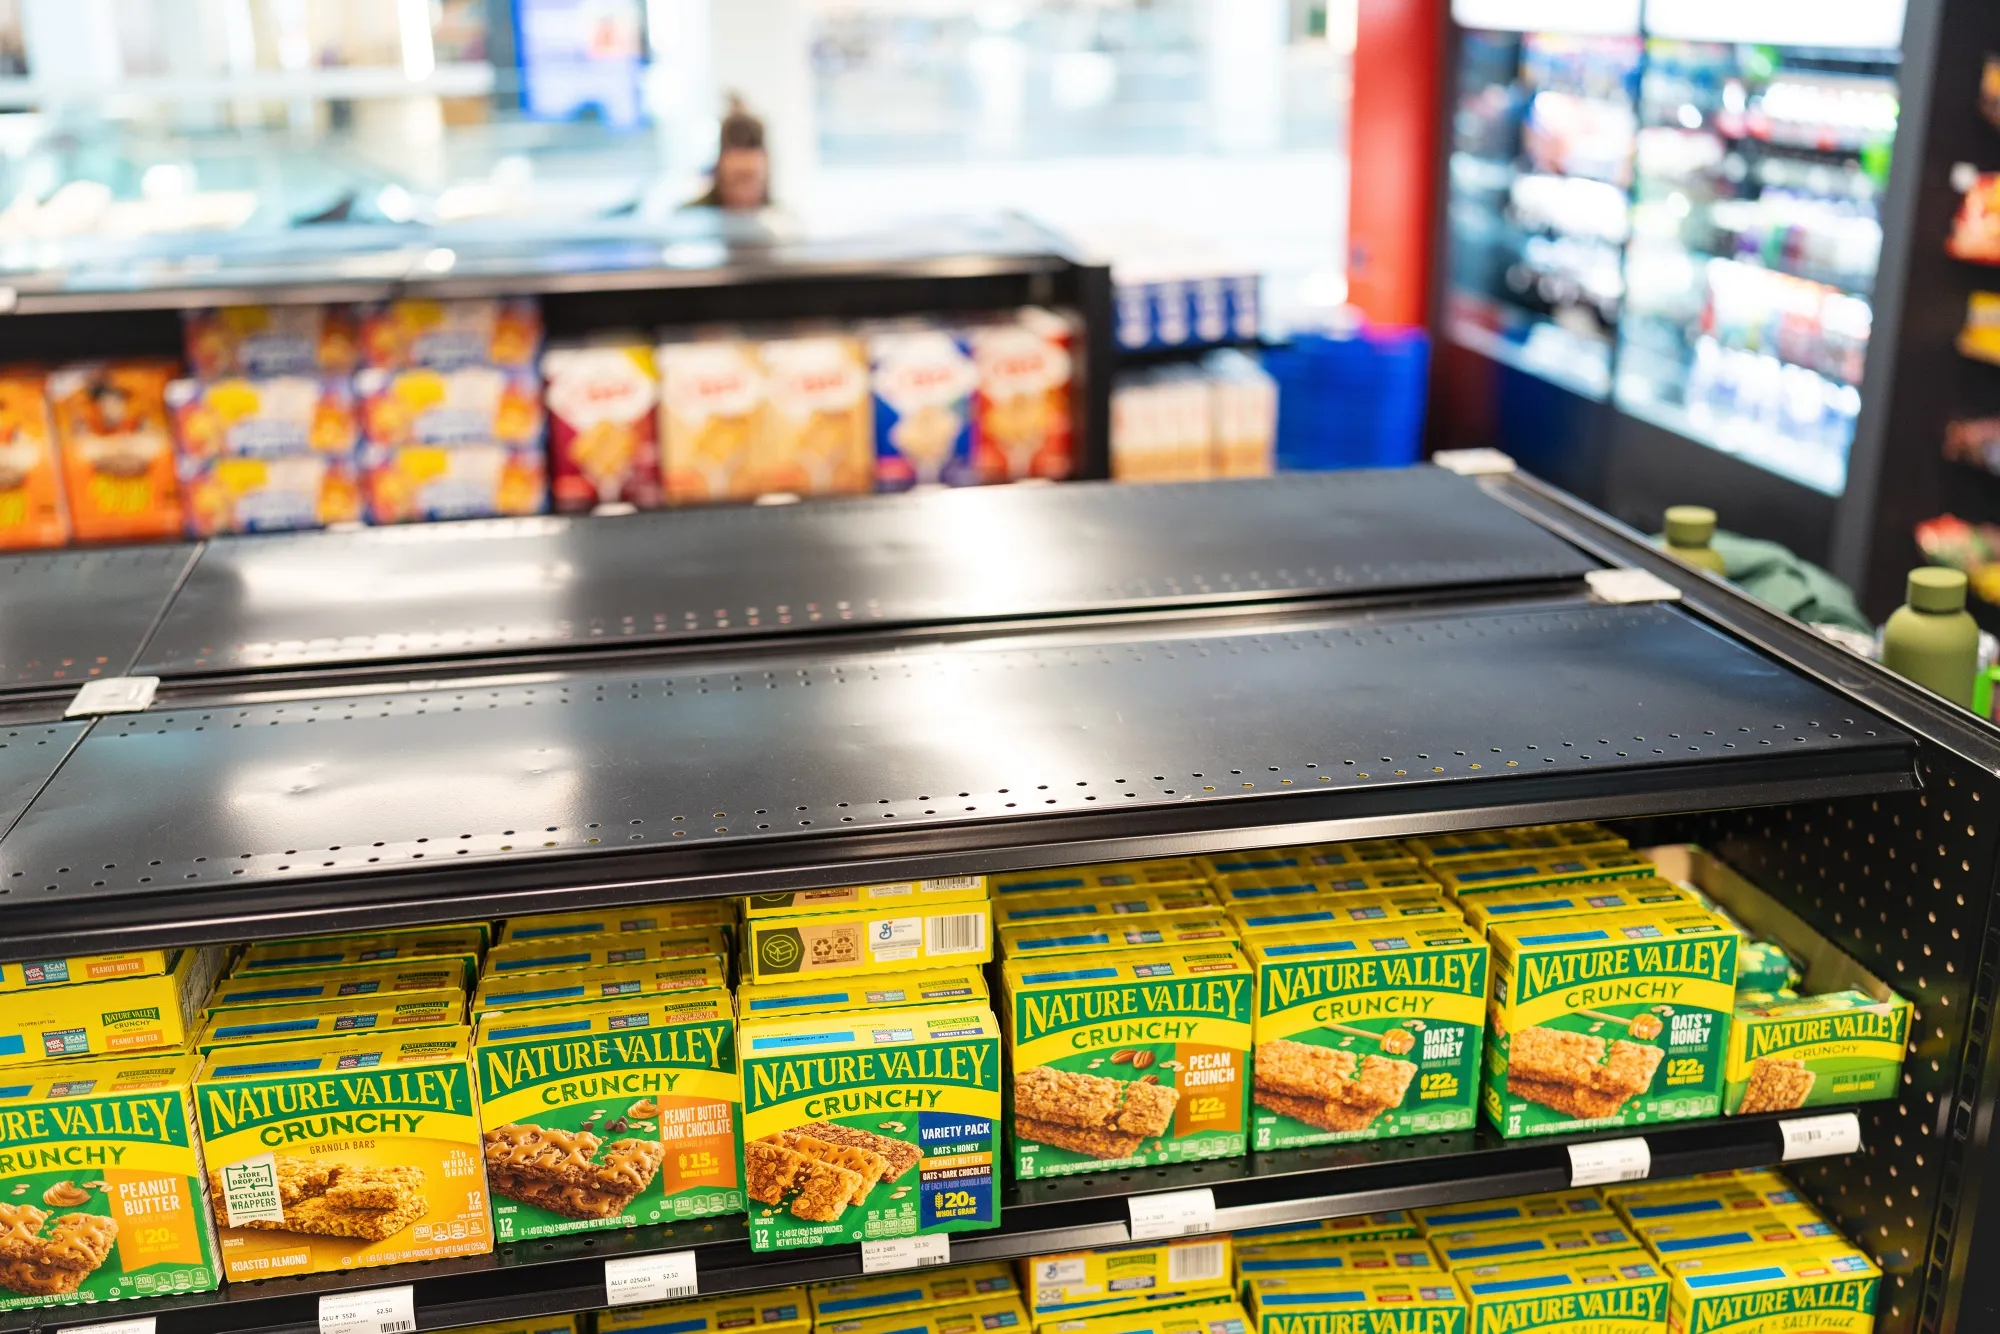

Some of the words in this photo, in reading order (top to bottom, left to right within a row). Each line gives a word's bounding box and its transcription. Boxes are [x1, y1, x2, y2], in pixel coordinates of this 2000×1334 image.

[44, 962, 66, 972] SCAN
[92, 965, 116, 974] PEANUT
[117, 962, 140, 972] BUTTER
[1523, 948, 1630, 1000] NATURE
[1634, 940, 1732, 981] VALLEY
[1268, 960, 1378, 1012] NATURE
[1380, 952, 1480, 995] VALLEY
[1565, 982, 1684, 1008] CRUNCHY
[1024, 989, 1138, 1039] NATURE
[1140, 979, 1244, 1020] VALLEY
[1313, 996, 1434, 1022] CRUNCHY
[104, 1012, 131, 1026] NATURE
[131, 1008, 158, 1020] VALLEY
[1672, 1014, 1702, 1030] OATS
[114, 1020, 151, 1030] CRUNCHY
[962, 1028, 976, 1036] PACK
[64, 1034, 86, 1042] SCAN
[111, 1036, 134, 1046] PEANUT
[136, 1033, 158, 1043] BUTTER
[1071, 1022, 1198, 1049] CRUNCHY
[1424, 1028, 1454, 1044] OATS
[1670, 1028, 1710, 1046] HONEY
[1750, 1018, 1832, 1058] NATURE
[1833, 1010, 1904, 1042] VALLEY
[46, 1040, 61, 1048] BOX
[1423, 1041, 1463, 1060] HONEY
[1793, 1045, 1860, 1060] CRUNCHY
[487, 1040, 611, 1096] NATURE
[611, 1026, 726, 1069] VALLEY
[1189, 1052, 1230, 1070] PECAN
[752, 1054, 876, 1108] NATURE
[878, 1044, 990, 1086] VALLEY
[1184, 1068, 1234, 1086] CRUNCH
[542, 1074, 680, 1104] CRUNCHY
[207, 1081, 340, 1135] NATURE
[340, 1068, 458, 1110] VALLEY
[804, 1090, 943, 1118] CRUNCHY
[49, 1098, 172, 1142] VALLEY
[664, 1107, 695, 1124] PEANUT
[698, 1104, 728, 1120] BUTTER
[260, 1113, 424, 1146] CRUNCHY
[663, 1124, 684, 1140] DARK
[686, 1119, 731, 1138] CHOCOLATE
[922, 1126, 962, 1140] VARIETY
[964, 1123, 990, 1136] PACK
[1258, 1128, 1271, 1139] 12
[310, 1141, 350, 1154] GRANOLA
[353, 1140, 376, 1150] BARS
[934, 1146, 950, 1155] OATS
[957, 1143, 980, 1153] HONEY
[442, 1158, 474, 1169] WHOLE
[930, 1158, 956, 1168] PEANUT
[958, 1155, 983, 1165] BUTTER
[1020, 1157, 1034, 1170] 12
[922, 1172, 938, 1180] OATS
[942, 1170, 958, 1178] DARK
[958, 1166, 990, 1176] CHOCOLATE
[119, 1178, 177, 1199] PEANUT
[931, 1182, 943, 1190] EACH
[943, 1180, 959, 1189] FLAVOR
[960, 1179, 980, 1187] GRANOLA
[981, 1177, 992, 1185] BARS
[230, 1190, 274, 1200] RECYCLABLE
[467, 1191, 482, 1205] 12
[944, 1191, 976, 1208] 20g
[124, 1195, 181, 1216] BUTTER
[231, 1198, 276, 1210] WRAPPERS
[936, 1209, 956, 1218] WHOLE
[415, 1227, 429, 1235] 200
[499, 1218, 513, 1231] 12
[568, 1220, 588, 1230] POUCHES
[589, 1218, 598, 1228] NET
[598, 1218, 606, 1226] WT
[809, 1227, 823, 1235] 2-BAR
[822, 1225, 843, 1233] POUCHES
[868, 1222, 880, 1230] 190
[884, 1220, 898, 1228] 200
[500, 1230, 514, 1238] BARS
[755, 1230, 768, 1243] 12
[776, 1239, 785, 1247] NET
[785, 1238, 793, 1246] WT
[435, 1247, 443, 1255] NET
[231, 1258, 269, 1271] ROASTED
[272, 1254, 307, 1267] ALMOND
[137, 1276, 150, 1285] 200
[663, 1272, 678, 1280] $2.50
[20, 1297, 42, 1305] POUCHES
[44, 1296, 54, 1304] NET
[1696, 1290, 1788, 1333] NATURE
[1792, 1280, 1873, 1312] VALLEY
[1482, 1296, 1575, 1334] NATURE
[1578, 1286, 1664, 1321] VALLEY
[1369, 1310, 1460, 1334] VALLEY
